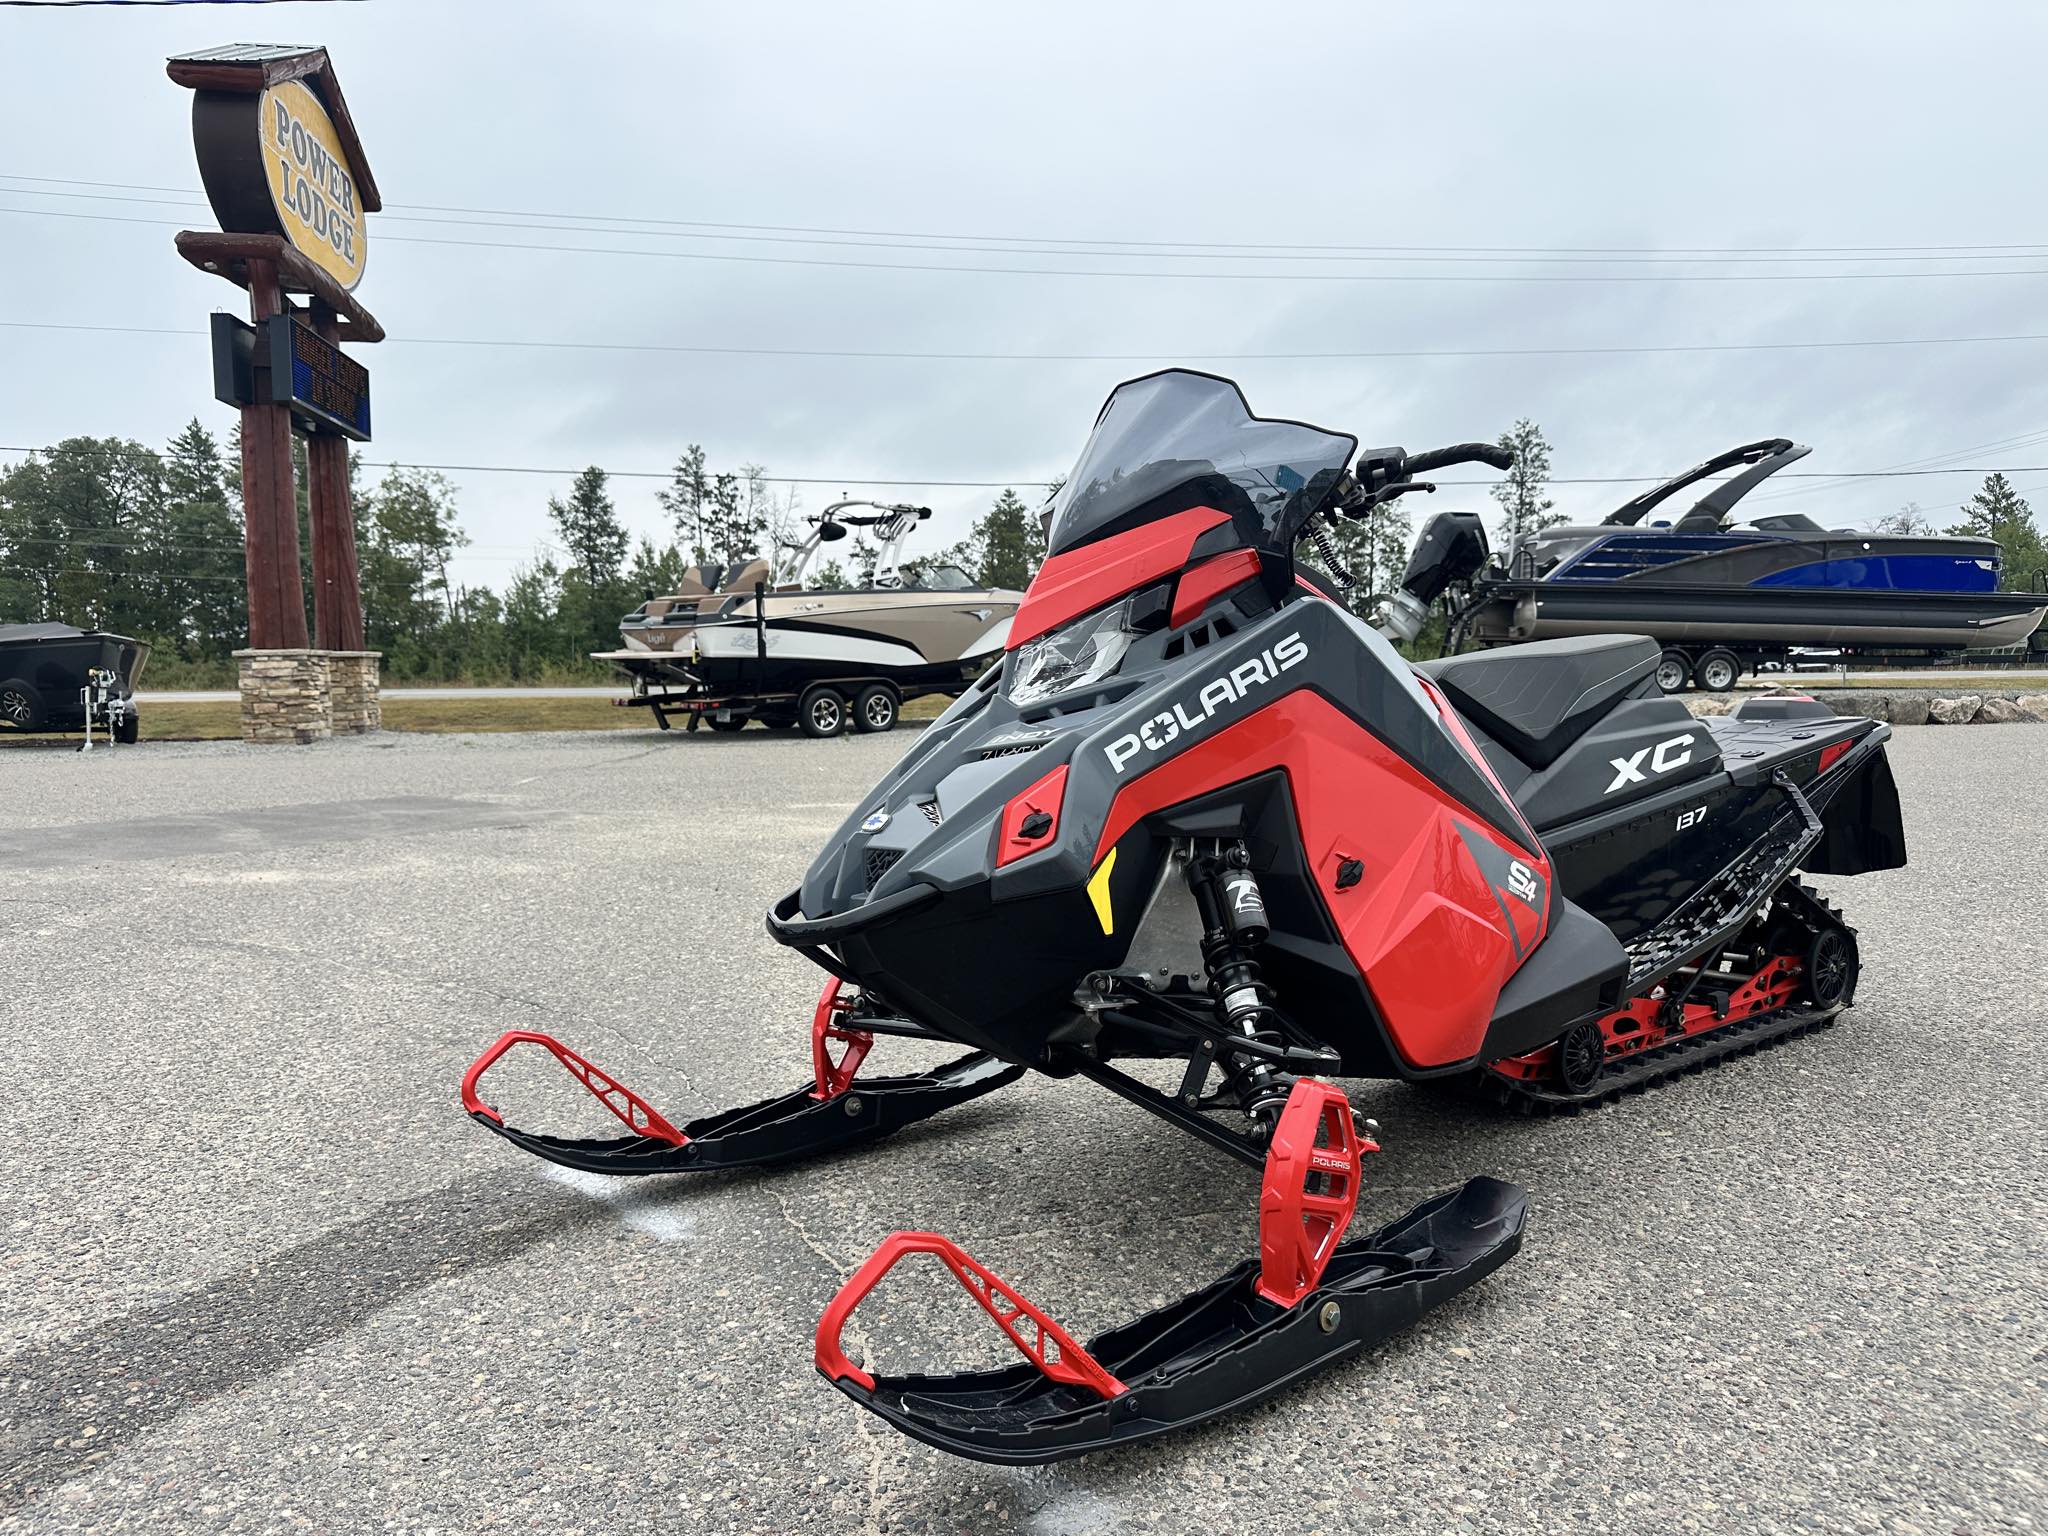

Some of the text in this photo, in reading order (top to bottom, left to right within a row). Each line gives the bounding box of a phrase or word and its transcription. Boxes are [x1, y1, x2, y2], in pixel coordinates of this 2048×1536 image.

[274, 98, 355, 220] POWER
[281, 159, 355, 264] LODGE
[1103, 631, 1309, 774] POLARIS
[990, 728, 1061, 744] INDY
[1603, 733, 1695, 795] XC
[1676, 805, 1708, 832] 137
[1507, 860, 1537, 903] S4
[1312, 1156, 1351, 1170] POLARIS
